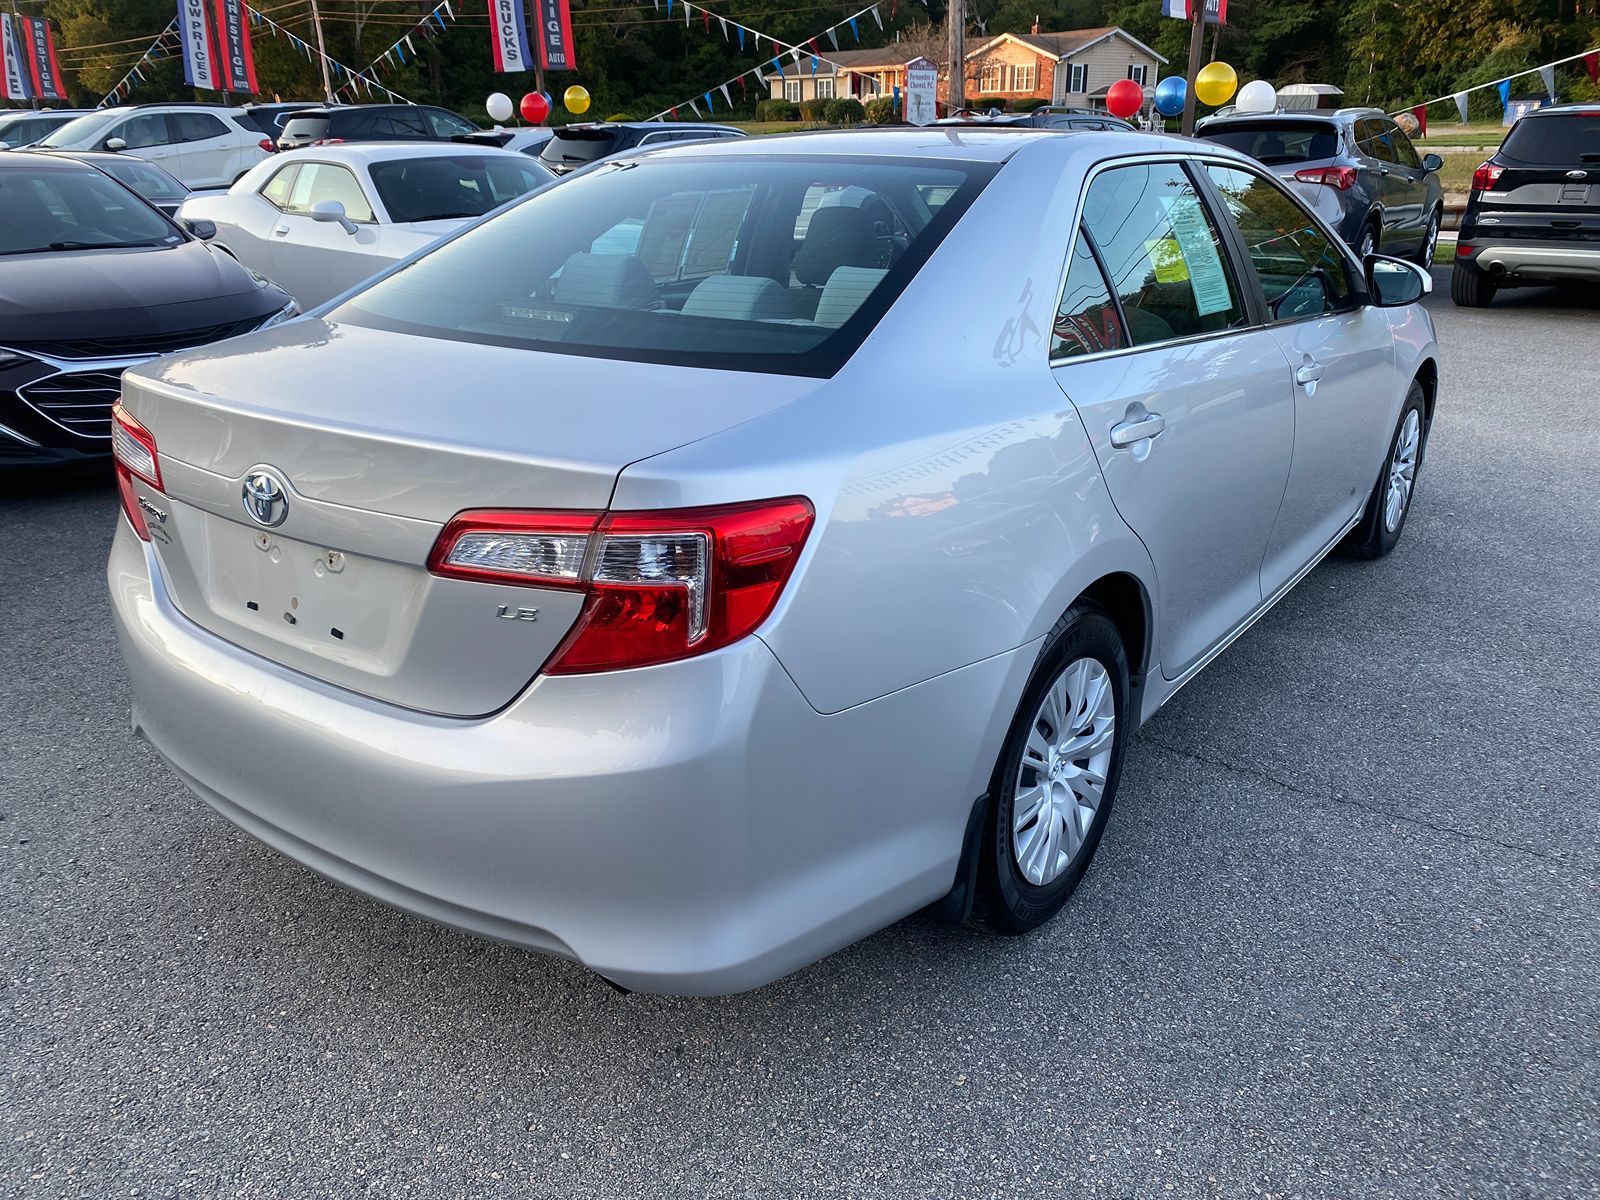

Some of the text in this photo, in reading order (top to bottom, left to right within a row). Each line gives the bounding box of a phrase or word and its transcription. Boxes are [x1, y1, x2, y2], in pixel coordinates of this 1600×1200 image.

[5, 20, 21, 94] SALE
[34, 22, 52, 88] PRESTIGE
[192, 21, 207, 80] PRICES
[548, 52, 565, 63] AUTO
[233, 80, 249, 89] AUTO
[496, 605, 539, 622] LE
